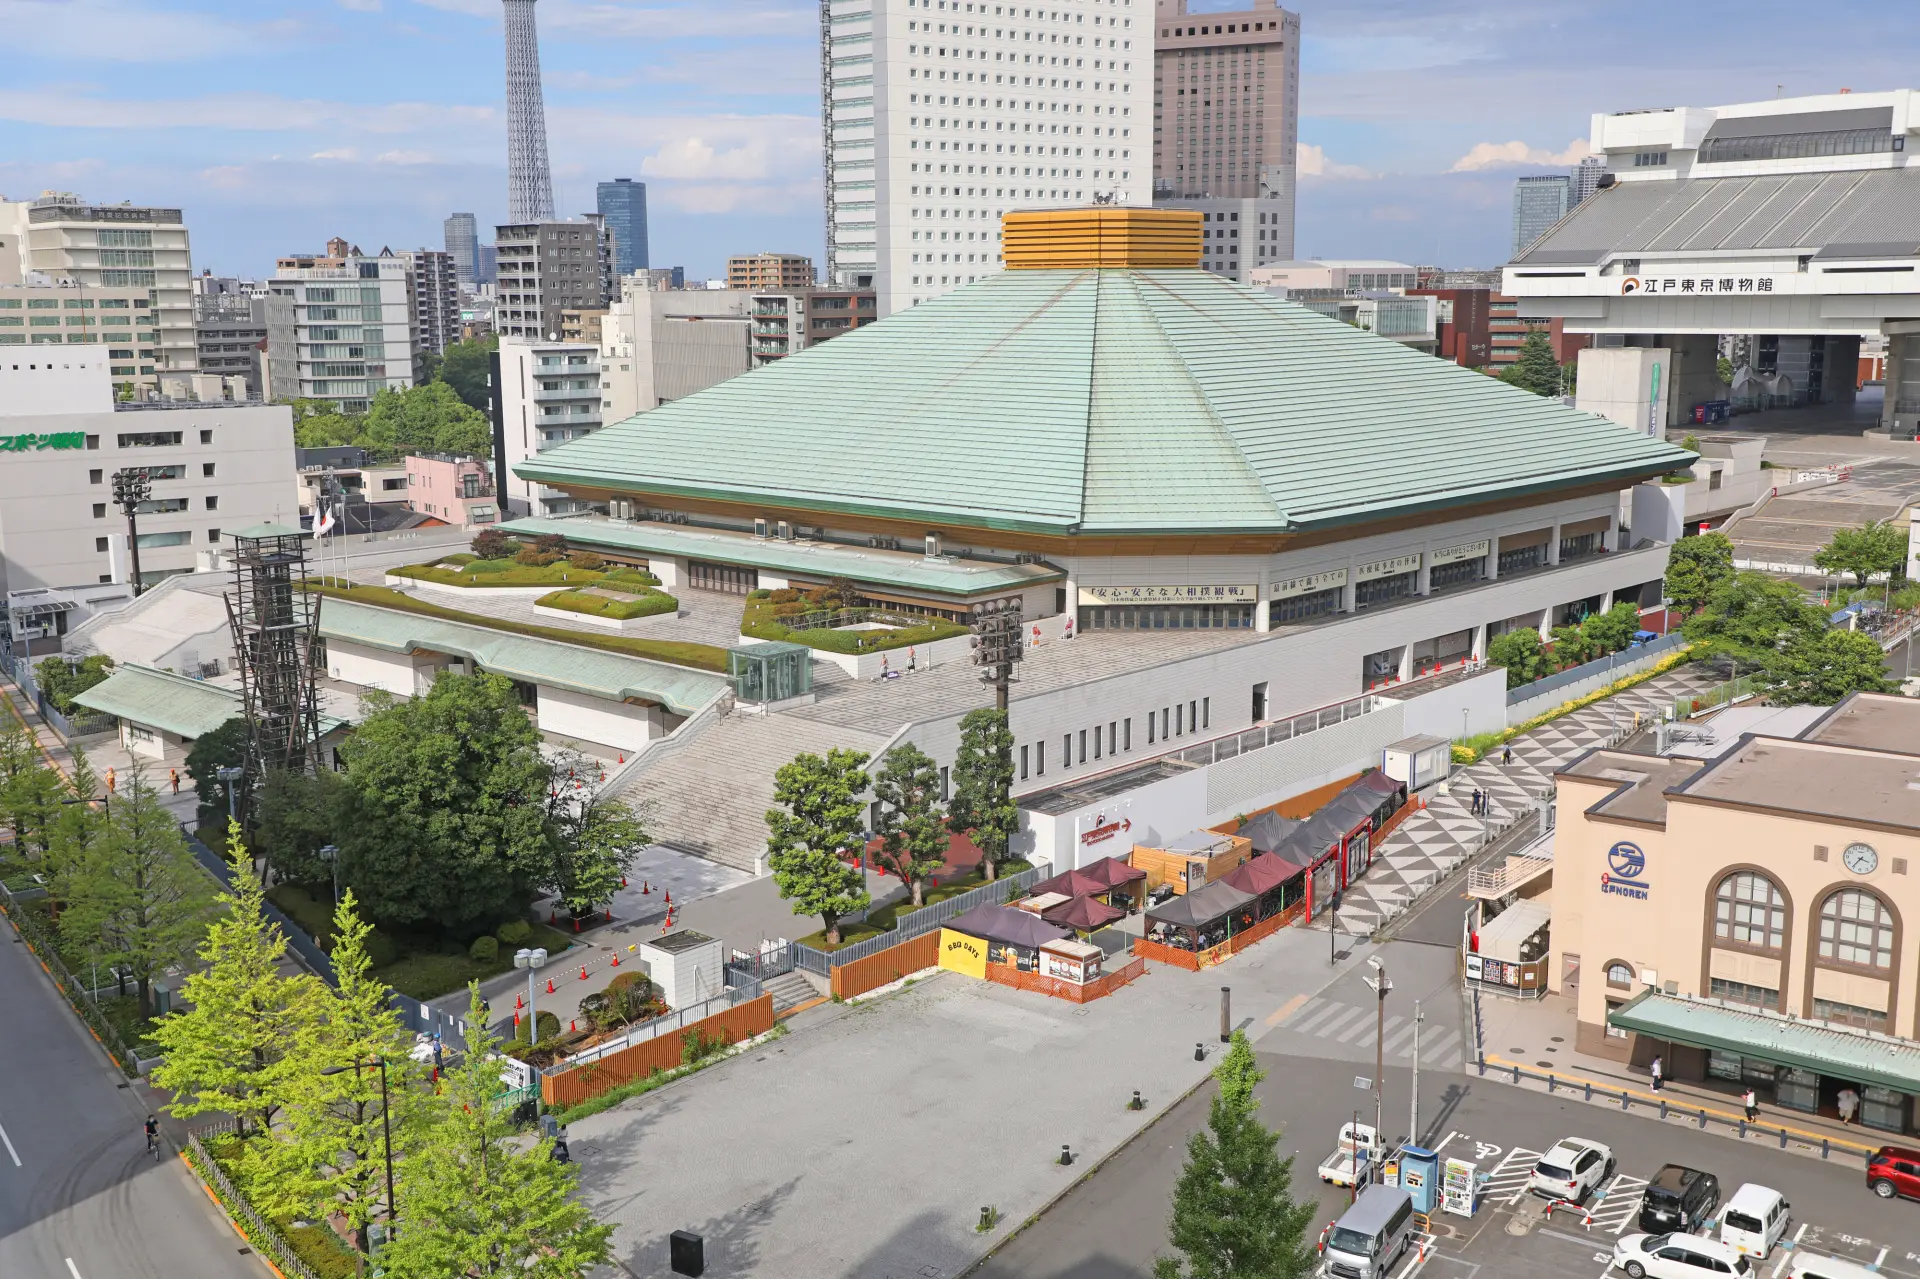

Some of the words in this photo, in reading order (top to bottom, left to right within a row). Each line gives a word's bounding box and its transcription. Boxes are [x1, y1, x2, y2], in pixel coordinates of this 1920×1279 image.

[1644, 277, 1773, 293] 江戸東京博物館
[948, 941, 962, 951] BBQ
[964, 942, 980, 959] DAYS
